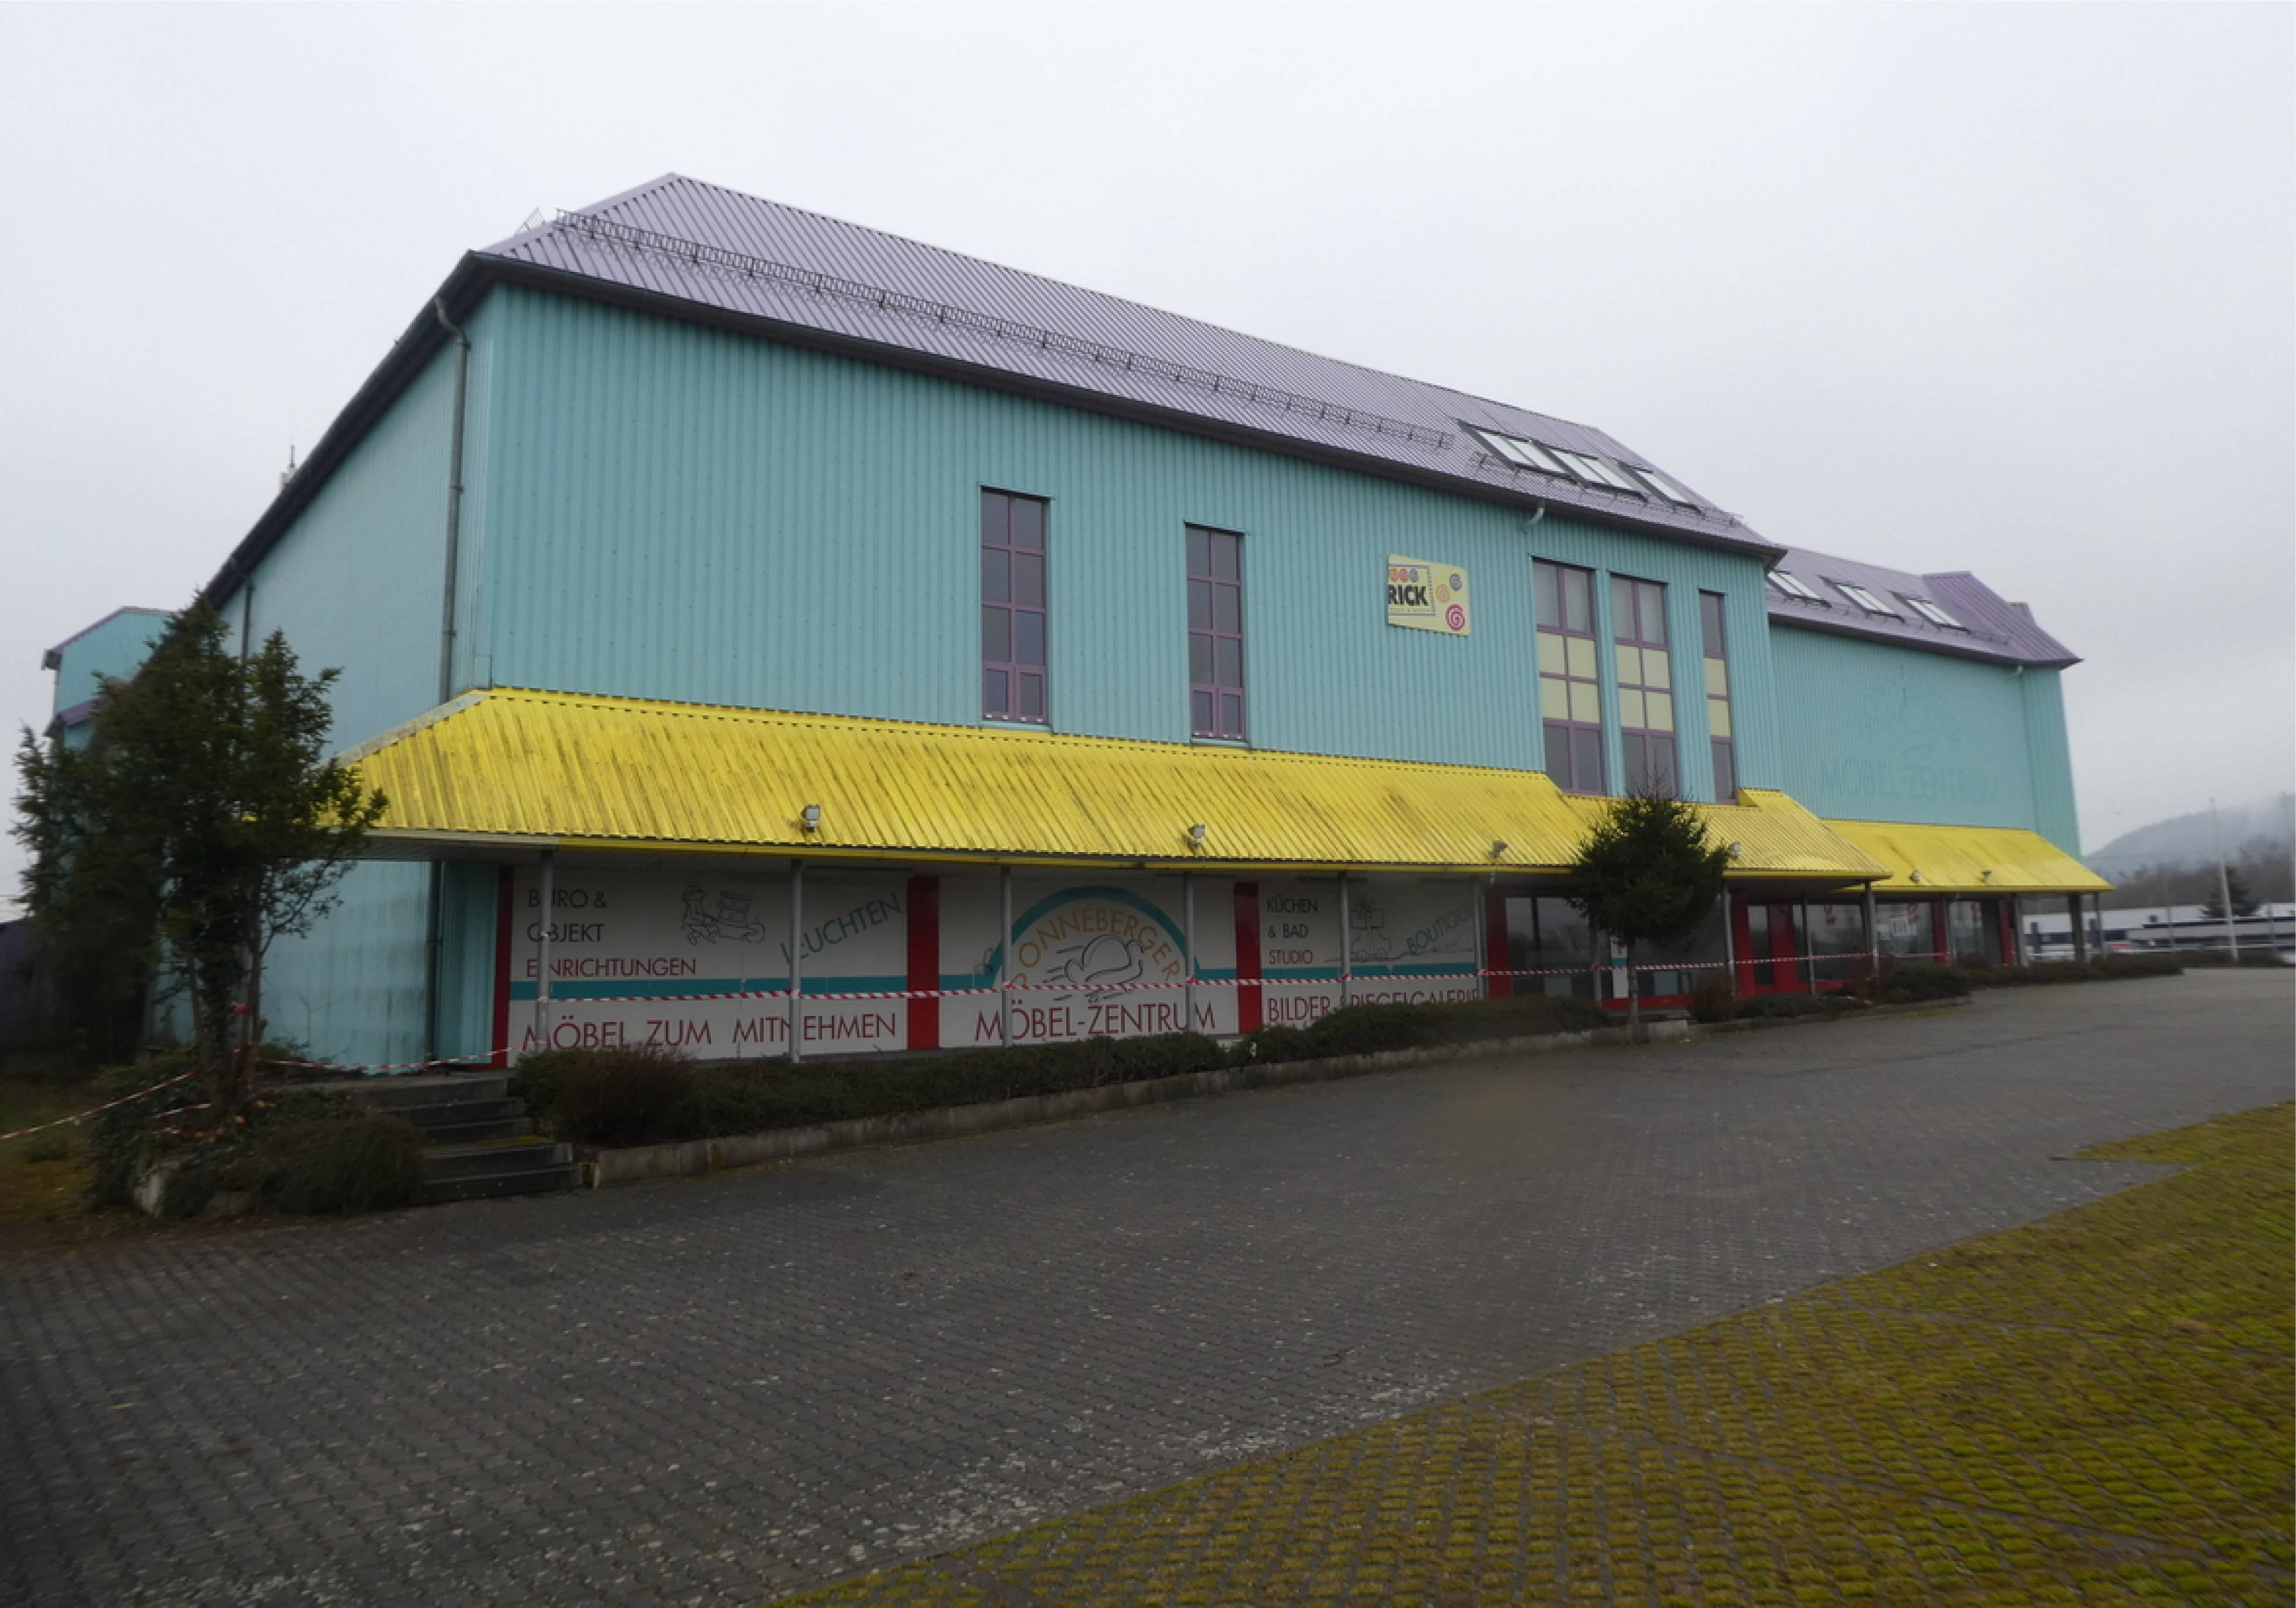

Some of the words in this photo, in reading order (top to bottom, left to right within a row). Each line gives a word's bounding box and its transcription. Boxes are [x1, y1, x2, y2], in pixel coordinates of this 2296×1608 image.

[1387, 584, 1429, 606] RICK
[528, 888, 588, 908] BRO
[593, 890, 608, 909] &
[1267, 893, 1318, 914] KÜCHEN
[1267, 925, 1276, 939] &
[1282, 923, 1309, 939] BAD
[1406, 903, 1473, 955] BOUTIQU
[527, 957, 697, 977] ENRICHTUNGEN
[1268, 949, 1314, 965] STUDIO
[646, 1019, 712, 1047] ZUM
[732, 1013, 896, 1044] MITNEHMEN
